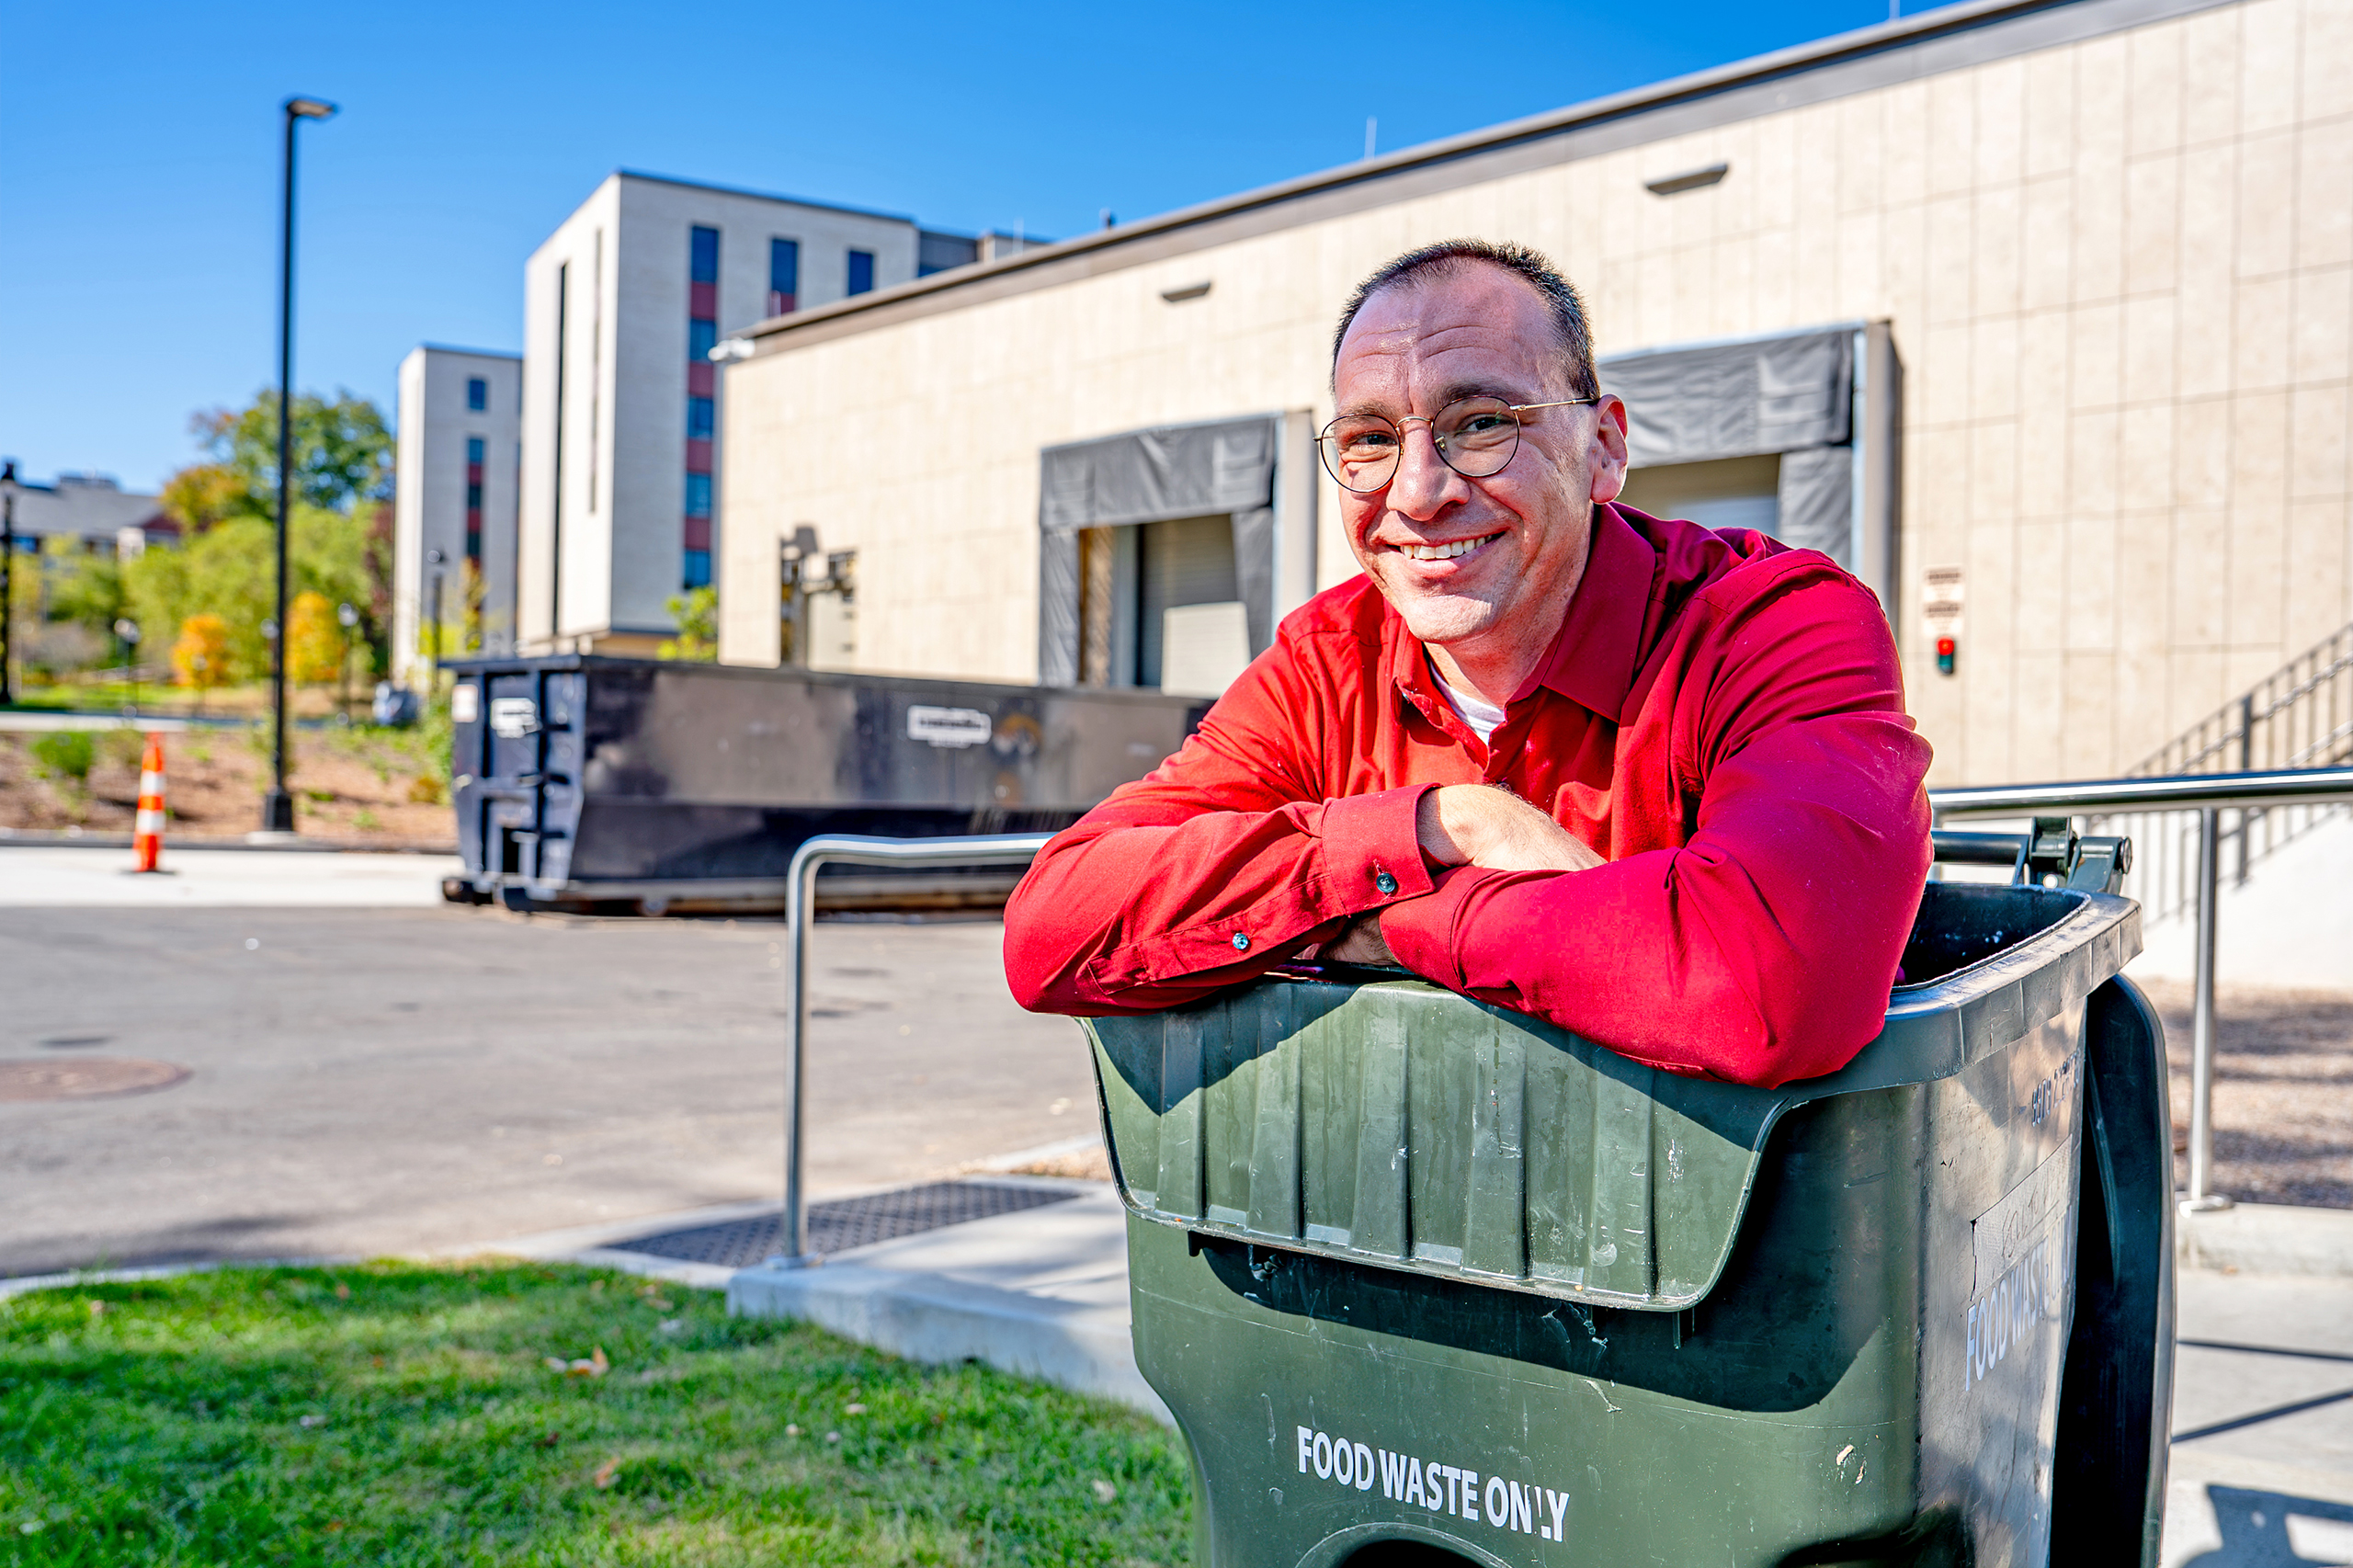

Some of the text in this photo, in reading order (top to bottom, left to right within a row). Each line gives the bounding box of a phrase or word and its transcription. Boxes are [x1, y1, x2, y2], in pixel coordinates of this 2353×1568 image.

[1966, 1278, 2007, 1392] FOOD
[2010, 1235, 2050, 1346] WASTE
[1297, 1426, 1375, 1491] FOOD
[1379, 1449, 1479, 1521] WASTE
